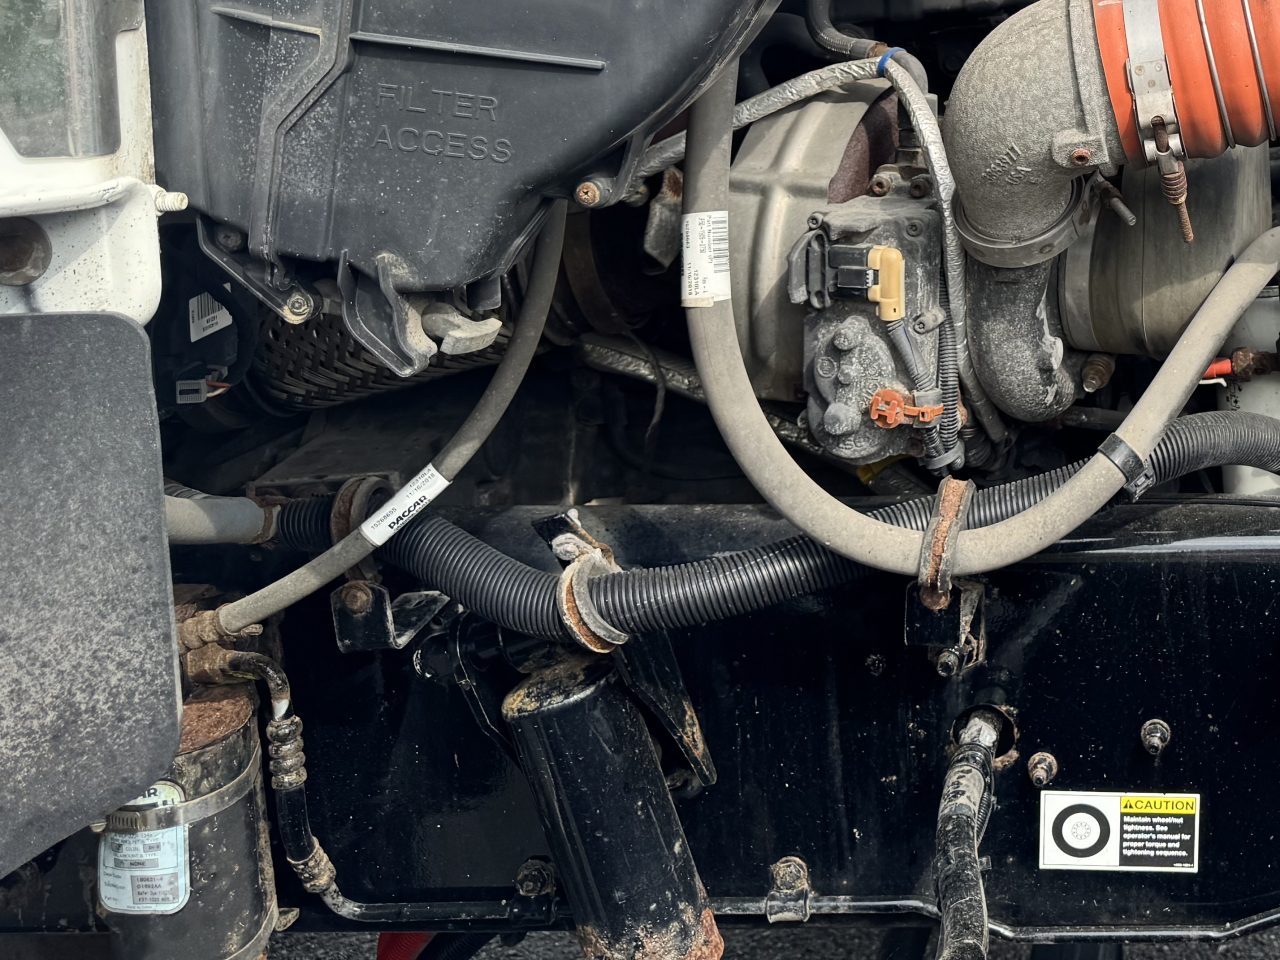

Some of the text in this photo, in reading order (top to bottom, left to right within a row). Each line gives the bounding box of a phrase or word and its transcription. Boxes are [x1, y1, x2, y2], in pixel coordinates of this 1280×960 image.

[375, 82, 499, 121] FILTER
[370, 124, 512, 163] ACCESS
[388, 495, 428, 530] PACCAR
[1134, 799, 1194, 810] CAUTION
[1123, 815, 1151, 823] Maintain
[1122, 849, 1155, 857] tightening
